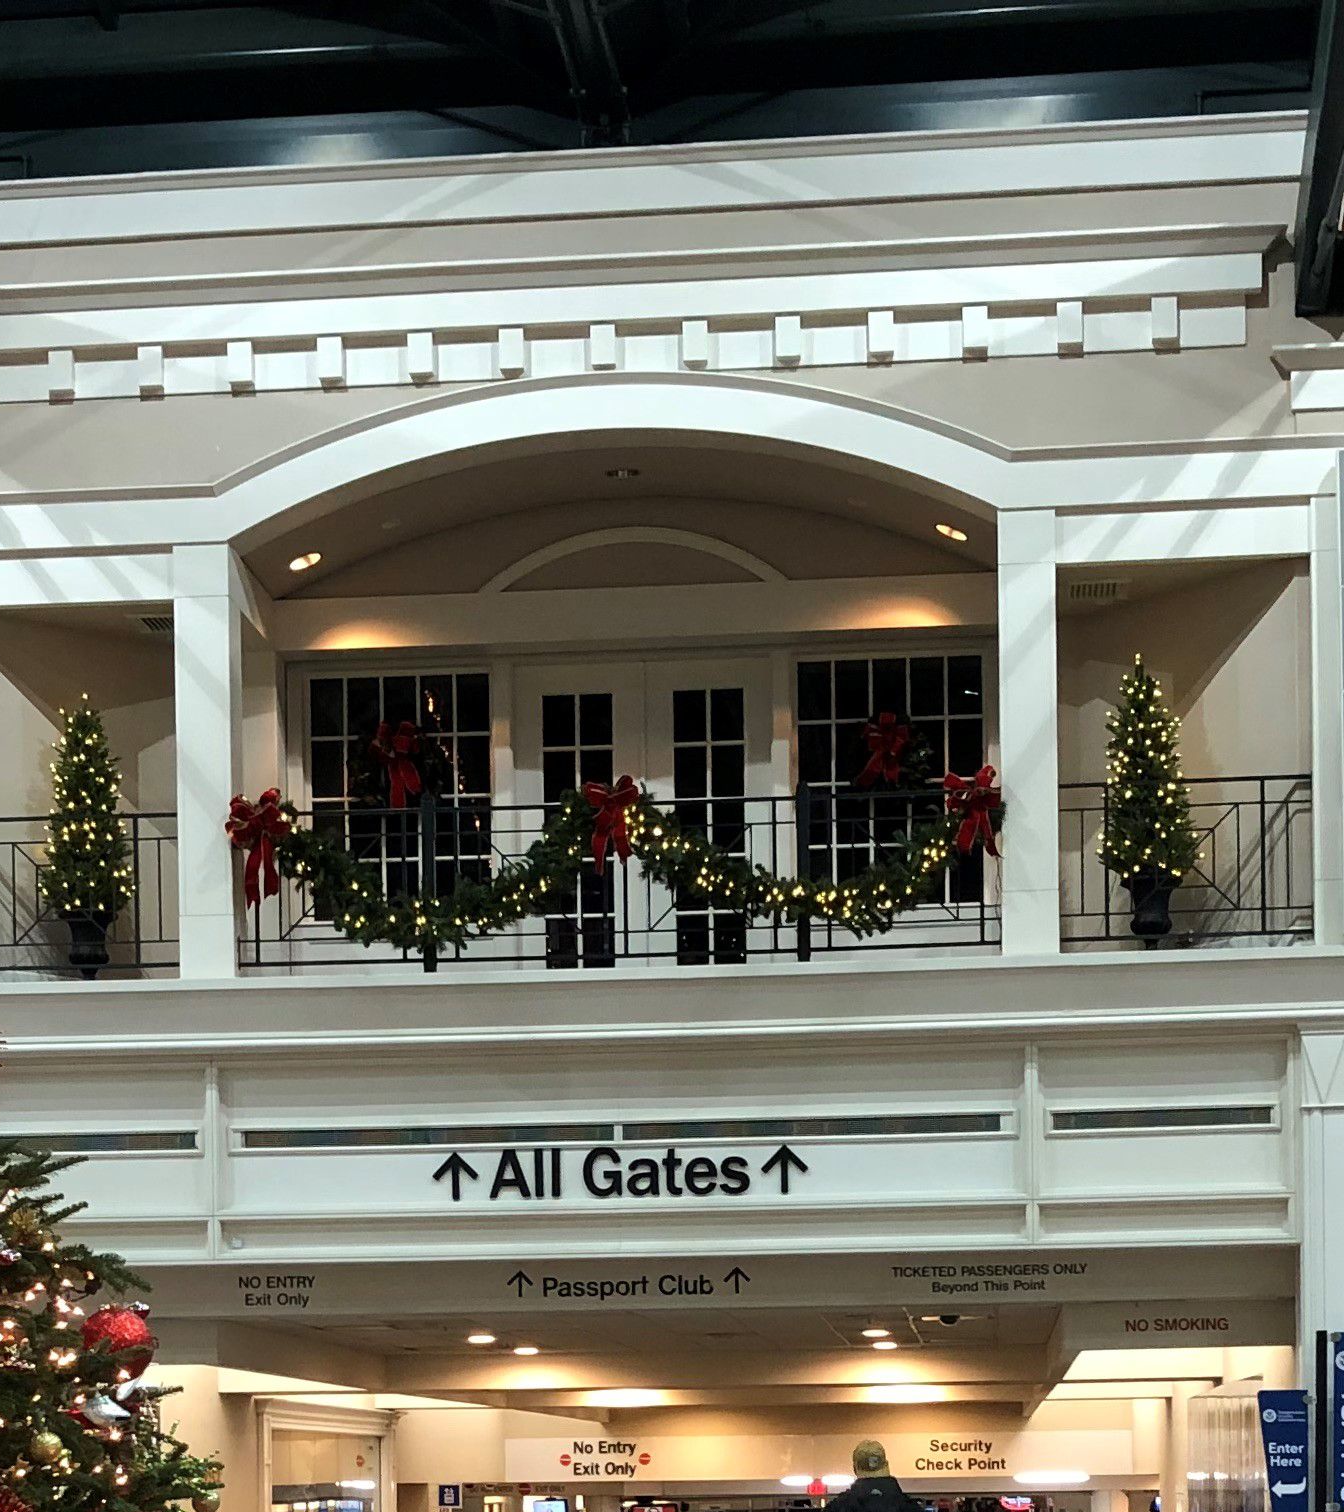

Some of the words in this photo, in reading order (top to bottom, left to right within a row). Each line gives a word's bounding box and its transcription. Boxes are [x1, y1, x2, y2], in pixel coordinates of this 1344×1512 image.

[490, 1148, 561, 1199] All
[583, 1147, 750, 1197] Gates
[892, 1266, 956, 1277] TICKETED
[961, 1264, 1049, 1276] PASSENGERS
[1053, 1263, 1088, 1275] ONLY
[239, 1276, 261, 1288] NO
[266, 1276, 315, 1288] ENTRY
[543, 1276, 649, 1300] Passport
[658, 1274, 714, 1295] Club
[932, 1281, 978, 1294] Beyond
[983, 1281, 1008, 1292] This
[1014, 1280, 1046, 1291] Point
[245, 1294, 271, 1306] Exit
[277, 1293, 309, 1308] Only
[1125, 1319, 1148, 1332] NO
[1154, 1318, 1229, 1331] SMOKING
[573, 1441, 593, 1454] No
[598, 1441, 636, 1456] Entry
[930, 1440, 992, 1454] Security
[1268, 1443, 1304, 1454] Enter
[915, 1458, 962, 1470] Check
[968, 1458, 1006, 1470] Point
[1270, 1456, 1302, 1467] Here
[573, 1462, 600, 1476] Exit
[605, 1462, 637, 1478] Only
